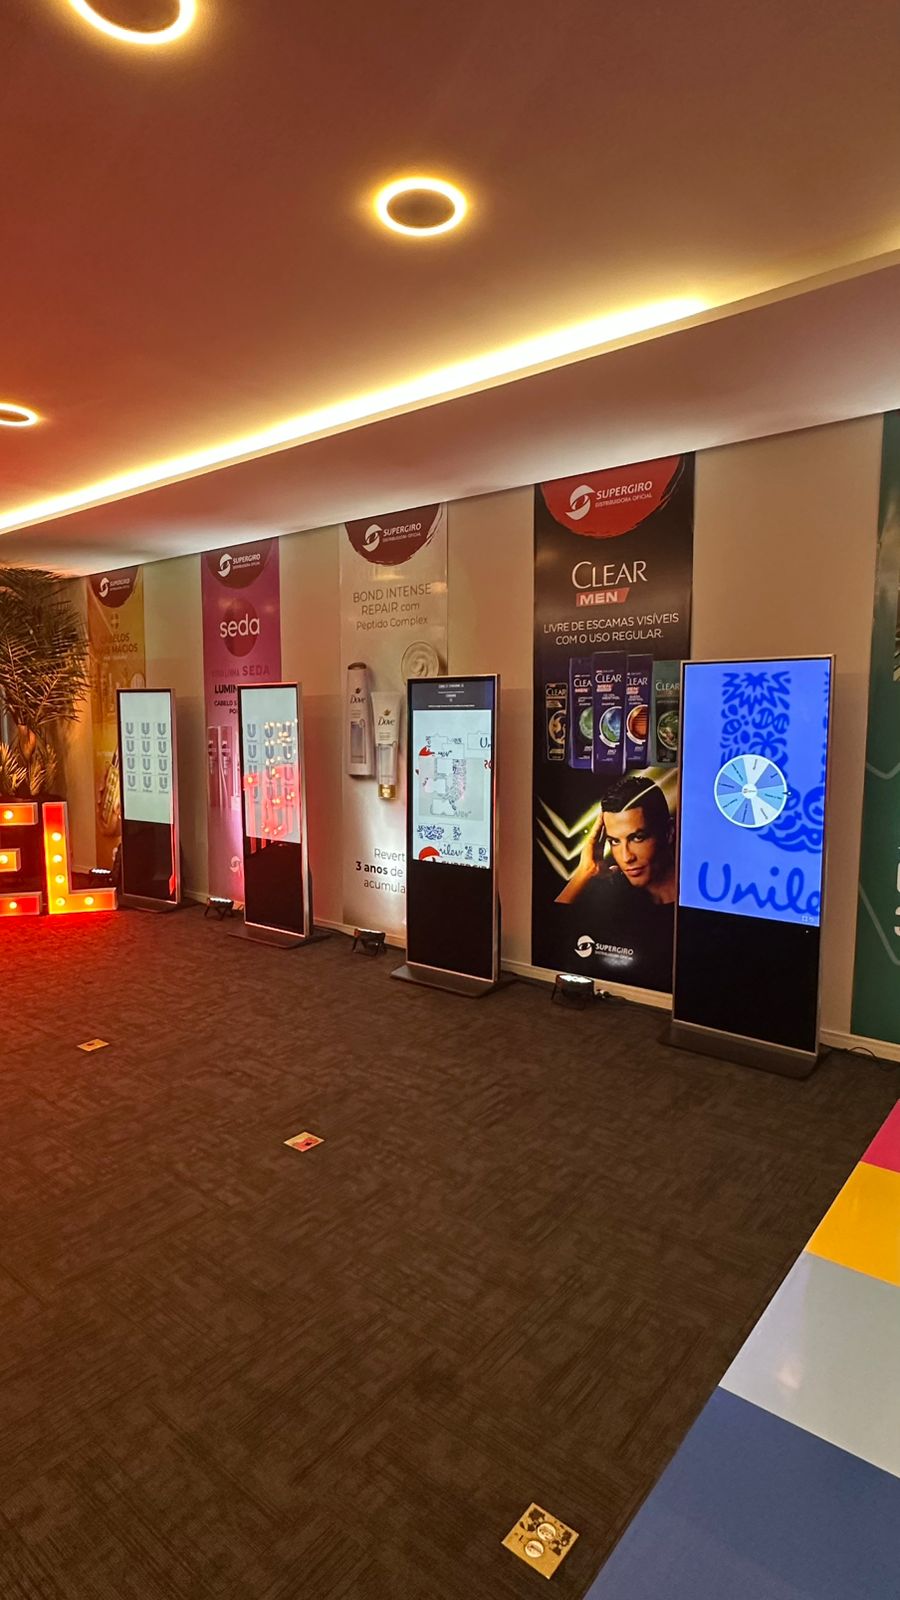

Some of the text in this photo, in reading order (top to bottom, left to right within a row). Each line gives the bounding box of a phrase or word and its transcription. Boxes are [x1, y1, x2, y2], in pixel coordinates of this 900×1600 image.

[596, 480, 653, 500] SUPERGIRO
[383, 522, 422, 537] SUPERGIRO
[232, 553, 261, 565] SUPERGIRO
[572, 560, 648, 589] CLEAR
[353, 583, 432, 603] BOND INTENSE
[580, 591, 618, 606] MEN
[361, 601, 420, 616] REPAIR com
[219, 613, 260, 638] seda
[390, 616, 428, 629] Complex
[543, 612, 680, 634] LIVRE DE ESCAMAS VISÍVEIS
[555, 628, 664, 646] COM O USO REGULAR.
[242, 664, 271, 676] SEDA
[595, 672, 622, 684] CLEAR
[374, 848, 405, 862] Revert
[355, 860, 404, 878] 3 anos de
[363, 879, 406, 894] acumula
[595, 942, 634, 956] SUPERGIRO
